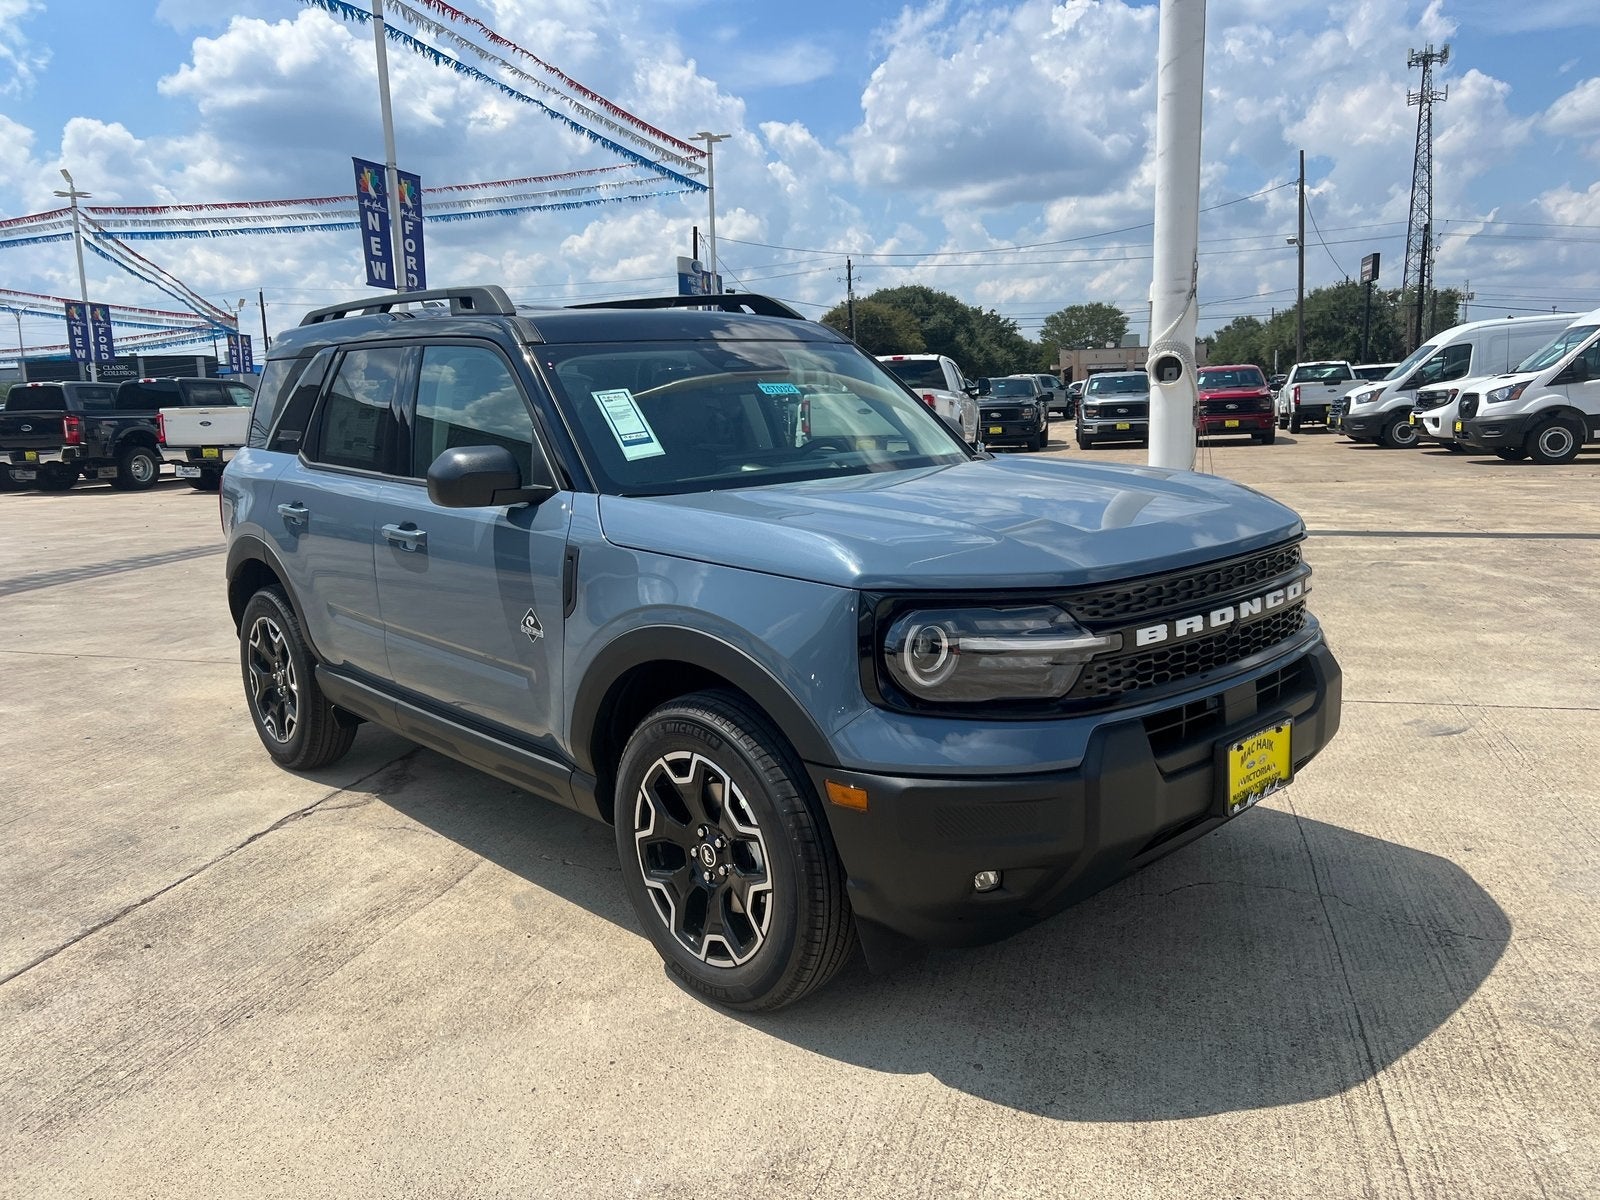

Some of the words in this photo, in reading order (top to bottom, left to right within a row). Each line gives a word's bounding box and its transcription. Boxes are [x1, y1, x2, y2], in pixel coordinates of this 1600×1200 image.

[367, 211, 386, 280] NEW
[405, 221, 419, 287] FORD
[73, 326, 86, 359] NEW
[98, 327, 109, 360] FORD
[231, 349, 239, 372] NEW
[1136, 581, 1302, 647] BRONCO
[665, 722, 720, 748] MICHELIN
[1240, 741, 1256, 768] MAC
[1256, 739, 1274, 752] HAIK
[1242, 763, 1271, 784] VICTORIA
